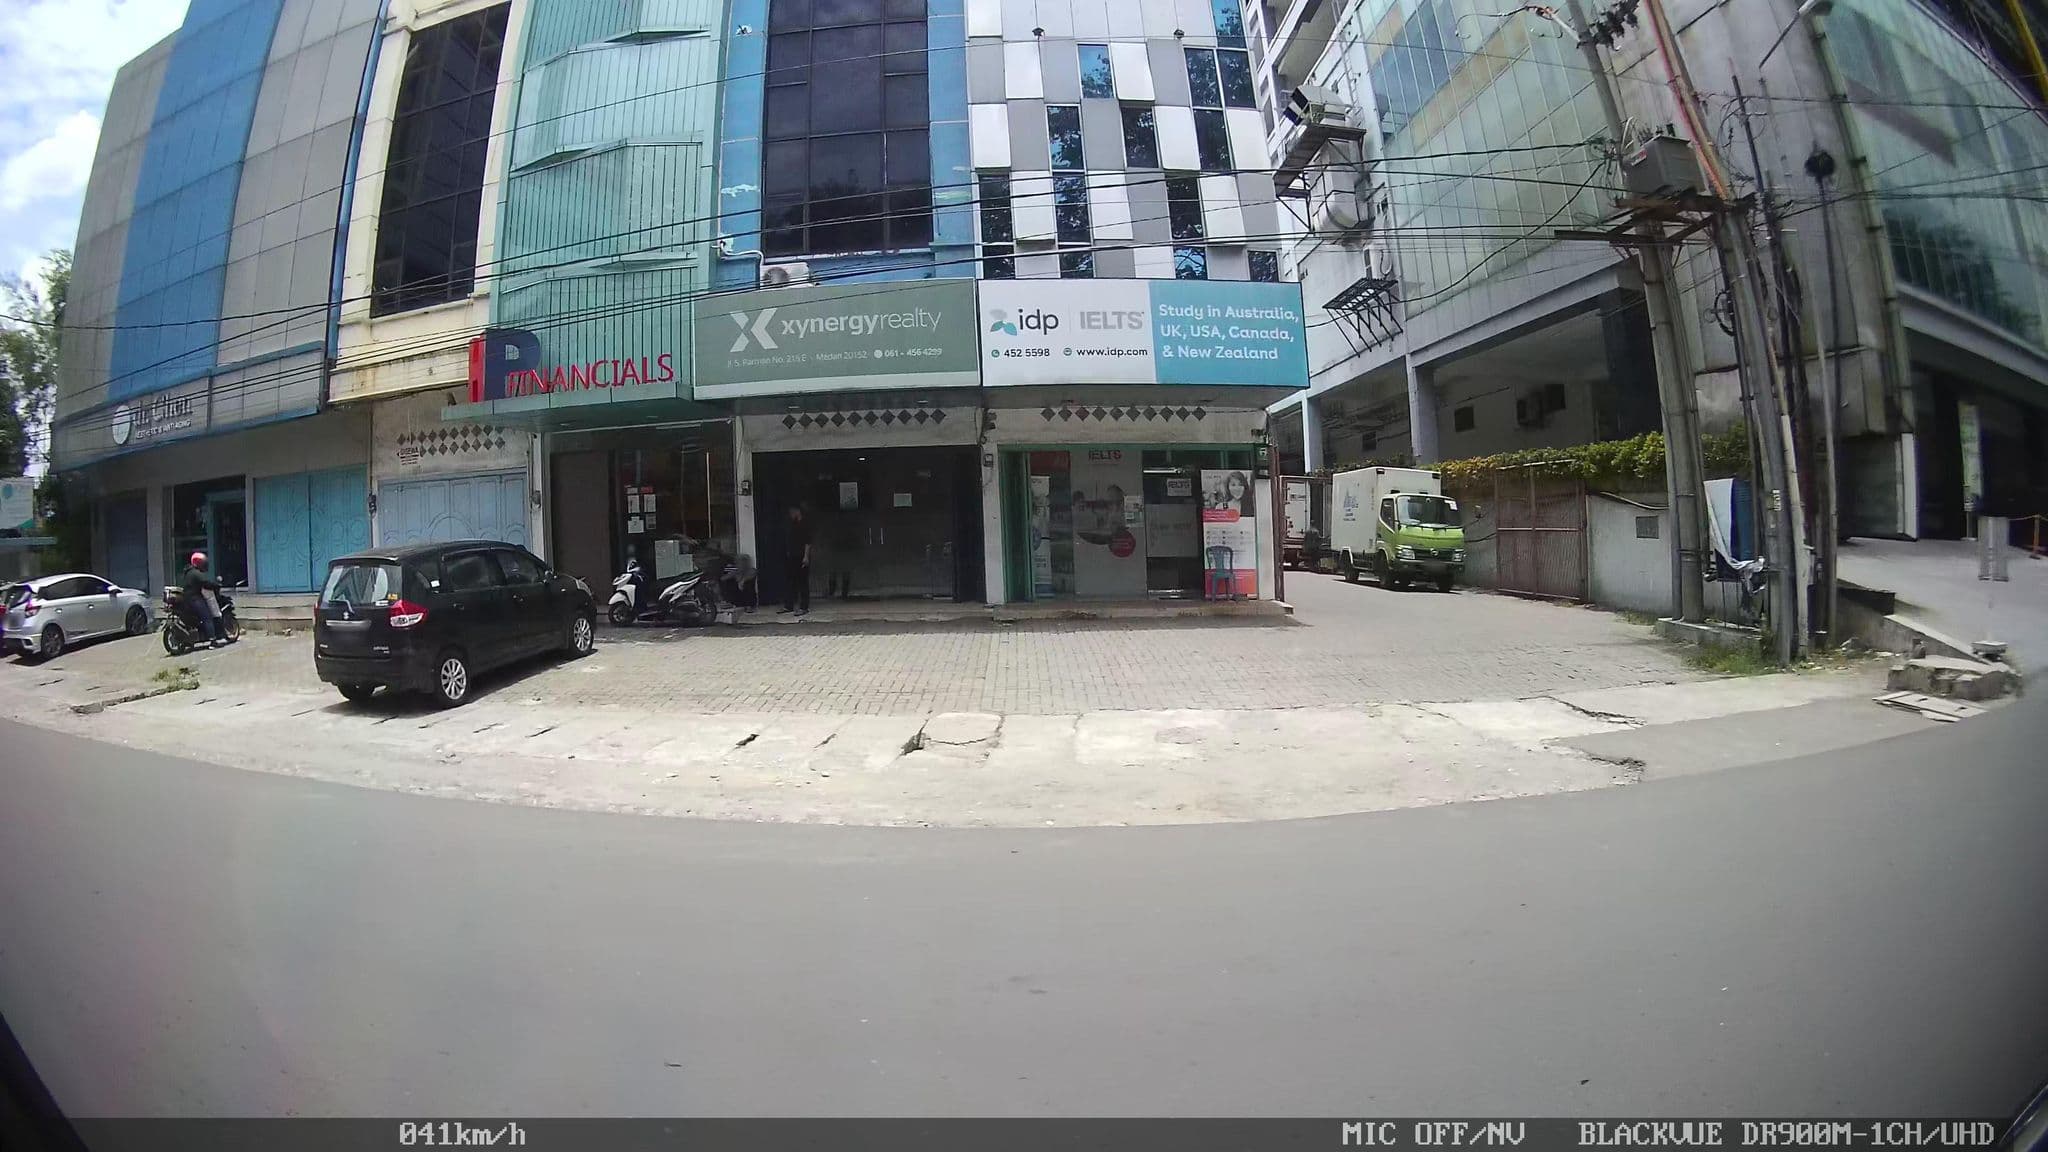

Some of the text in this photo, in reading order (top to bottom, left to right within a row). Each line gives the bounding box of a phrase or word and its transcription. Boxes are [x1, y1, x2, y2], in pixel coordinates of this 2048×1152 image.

[1018, 308, 1059, 335] idp
[1159, 304, 1299, 323] Study in Australia,
[781, 307, 942, 339] xynergyrealty
[1161, 325, 1295, 343] UK, USA, Canada,
[1003, 348, 1050, 358] 452 5598
[1076, 346, 1148, 361] www.idp.com
[1162, 345, 1279, 359] & New Zealand
[505, 353, 676, 399] FINANCIALS
